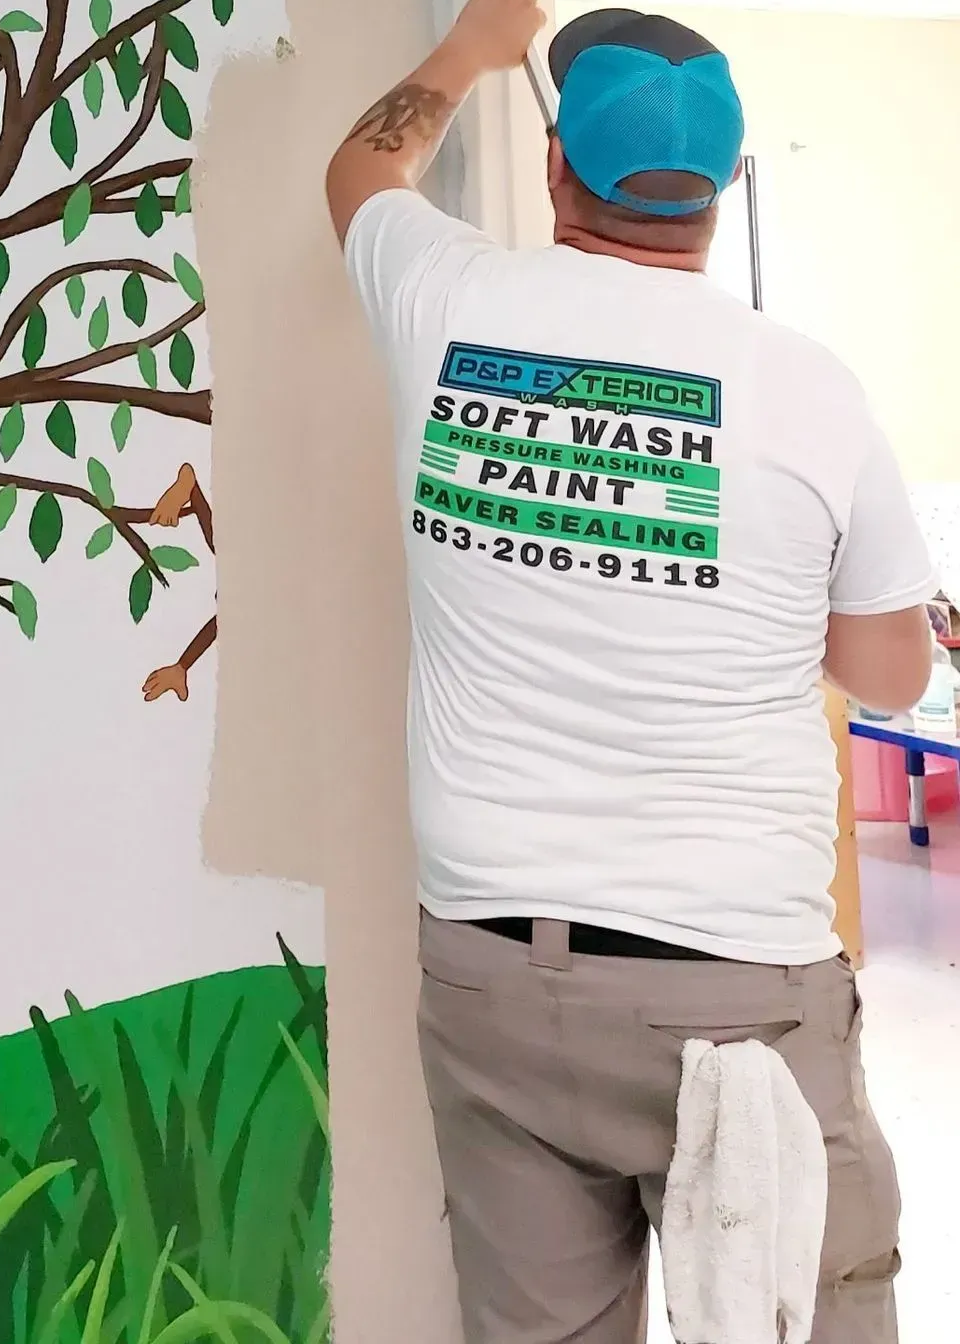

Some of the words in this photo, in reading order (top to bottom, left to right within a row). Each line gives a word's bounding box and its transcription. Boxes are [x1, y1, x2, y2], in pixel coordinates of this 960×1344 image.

[456, 357, 522, 382] P&P
[533, 367, 704, 410] EXTERIOR
[430, 395, 549, 438] SOFT
[571, 415, 713, 463] WASH
[448, 431, 563, 462] PRESSURE
[573, 452, 685, 480] WASHING
[478, 459, 634, 506] PAINT
[420, 482, 518, 526] PAVER
[535, 510, 706, 552] SEALING
[412, 510, 720, 589] 863-206-9118
